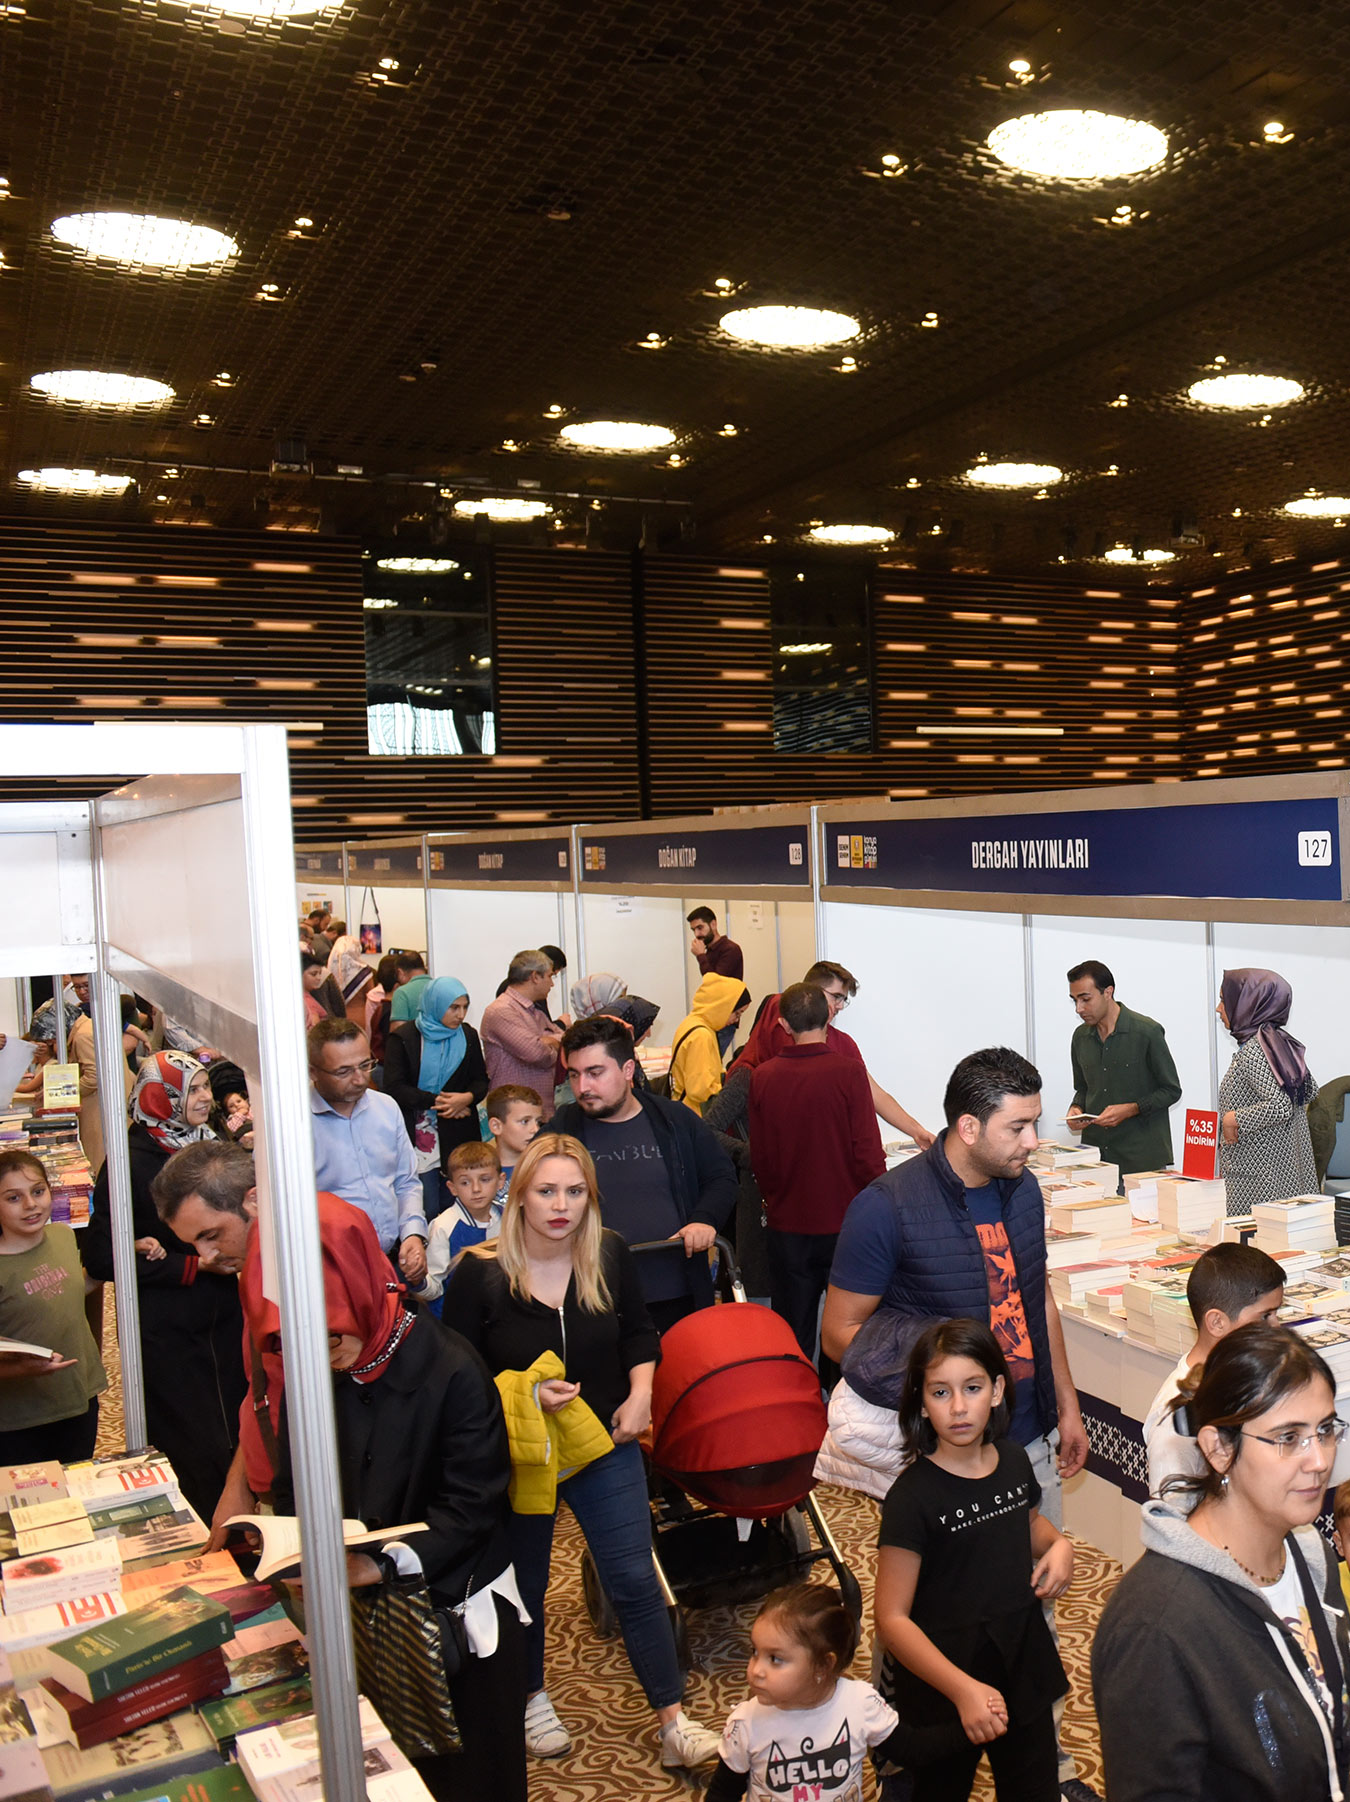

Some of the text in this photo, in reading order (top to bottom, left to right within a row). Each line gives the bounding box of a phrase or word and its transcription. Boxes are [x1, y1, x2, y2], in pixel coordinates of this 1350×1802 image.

[678, 844, 697, 868] KİTAP
[971, 838, 1089, 869] DERGAH YAYINLARI
[1304, 839, 1328, 858] 127
[1189, 1119, 1214, 1134] %35
[1186, 1133, 1215, 1147] İNDİRİM
[939, 1503, 980, 1525] YOU
[768, 1758, 849, 1787] HELLO
[792, 1783, 823, 1802] MY
